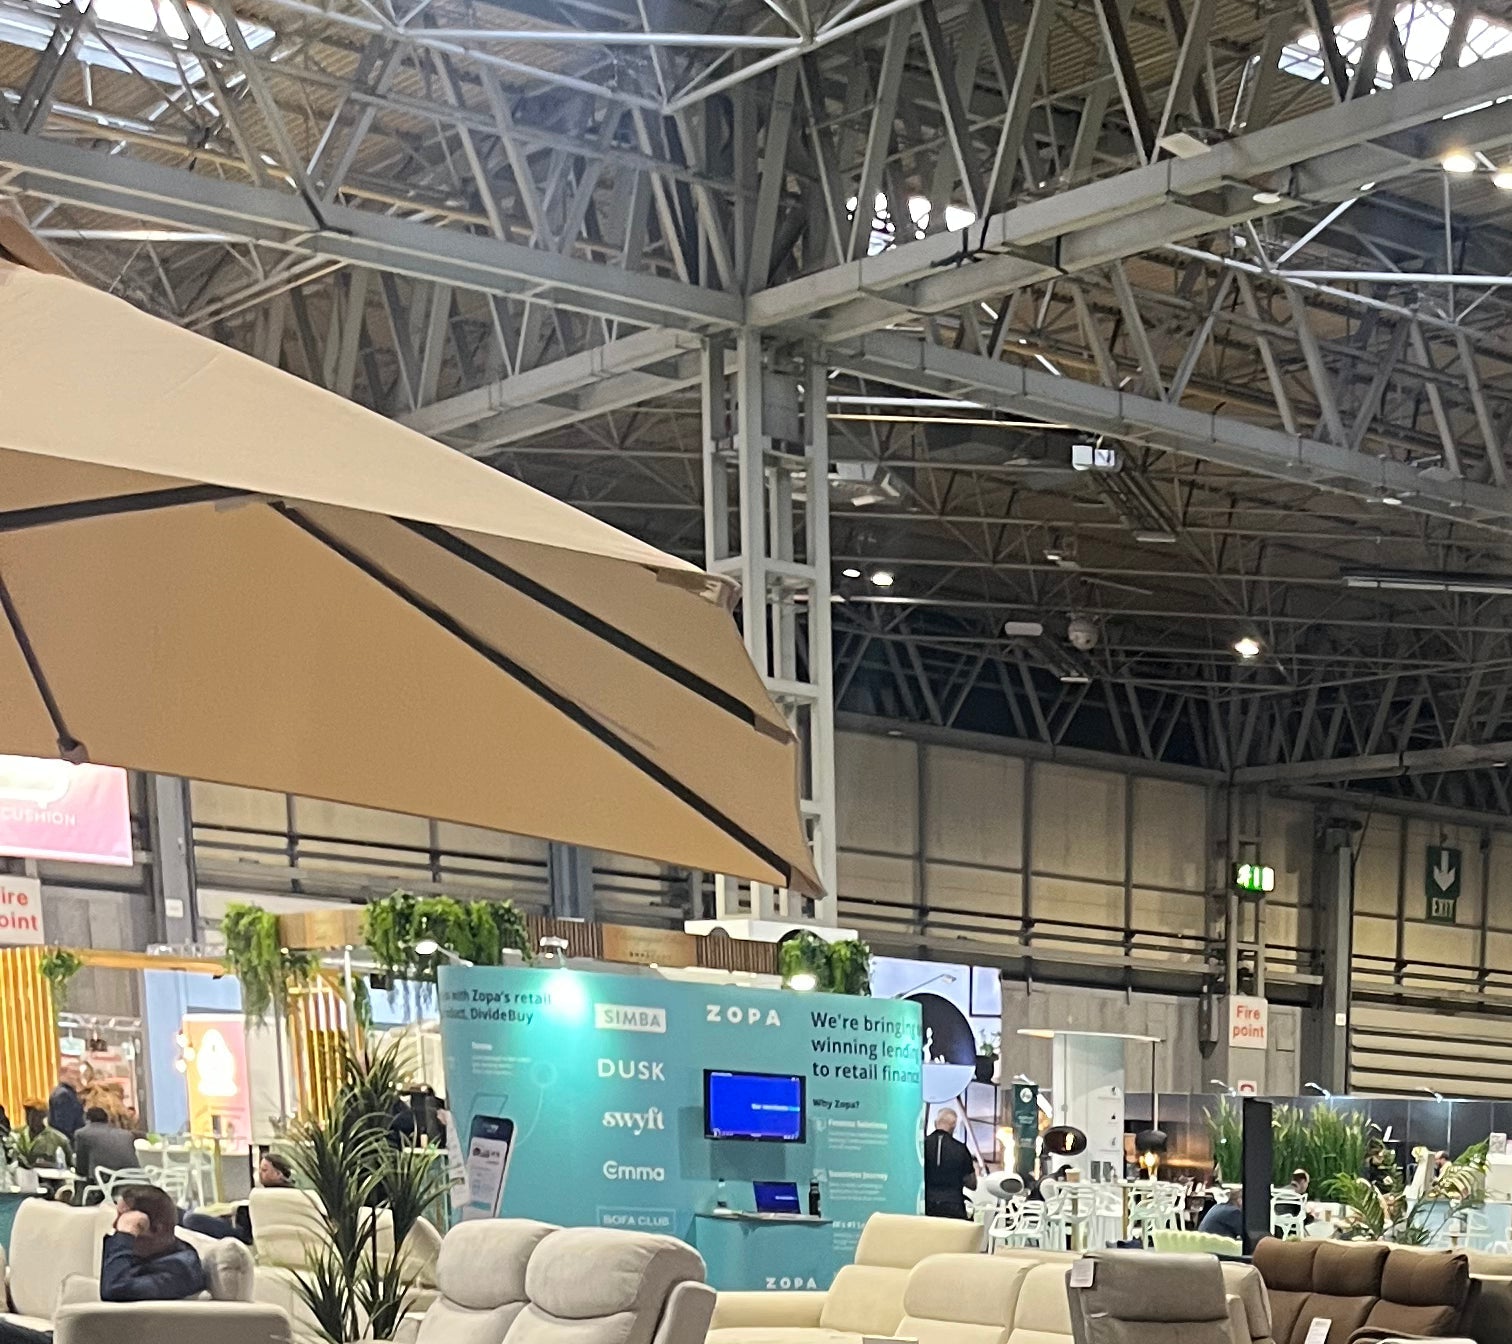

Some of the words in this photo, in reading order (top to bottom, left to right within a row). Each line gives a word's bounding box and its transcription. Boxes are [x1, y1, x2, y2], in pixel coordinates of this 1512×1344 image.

[1, 886, 28, 906] ire
[1431, 897, 1455, 918] EXIT
[0, 914, 38, 931] oint
[472, 989, 511, 1005] Zopa's
[514, 992, 552, 1005] retail
[470, 1008, 533, 1025] DivideBuy
[603, 1008, 661, 1028] SIMBA
[706, 1004, 781, 1027] ZOPA
[811, 1011, 859, 1031] We're
[1236, 1004, 1260, 1020] Fire
[1233, 1024, 1264, 1039] point
[811, 1037, 878, 1061] winning
[597, 1058, 666, 1082] DUSK
[812, 1062, 830, 1077] to
[835, 1064, 878, 1080] retail
[812, 1098, 832, 1110] Why
[602, 1107, 665, 1136] swyft
[638, 1215, 670, 1227] CLUB
[765, 1276, 817, 1290] ZOPA
